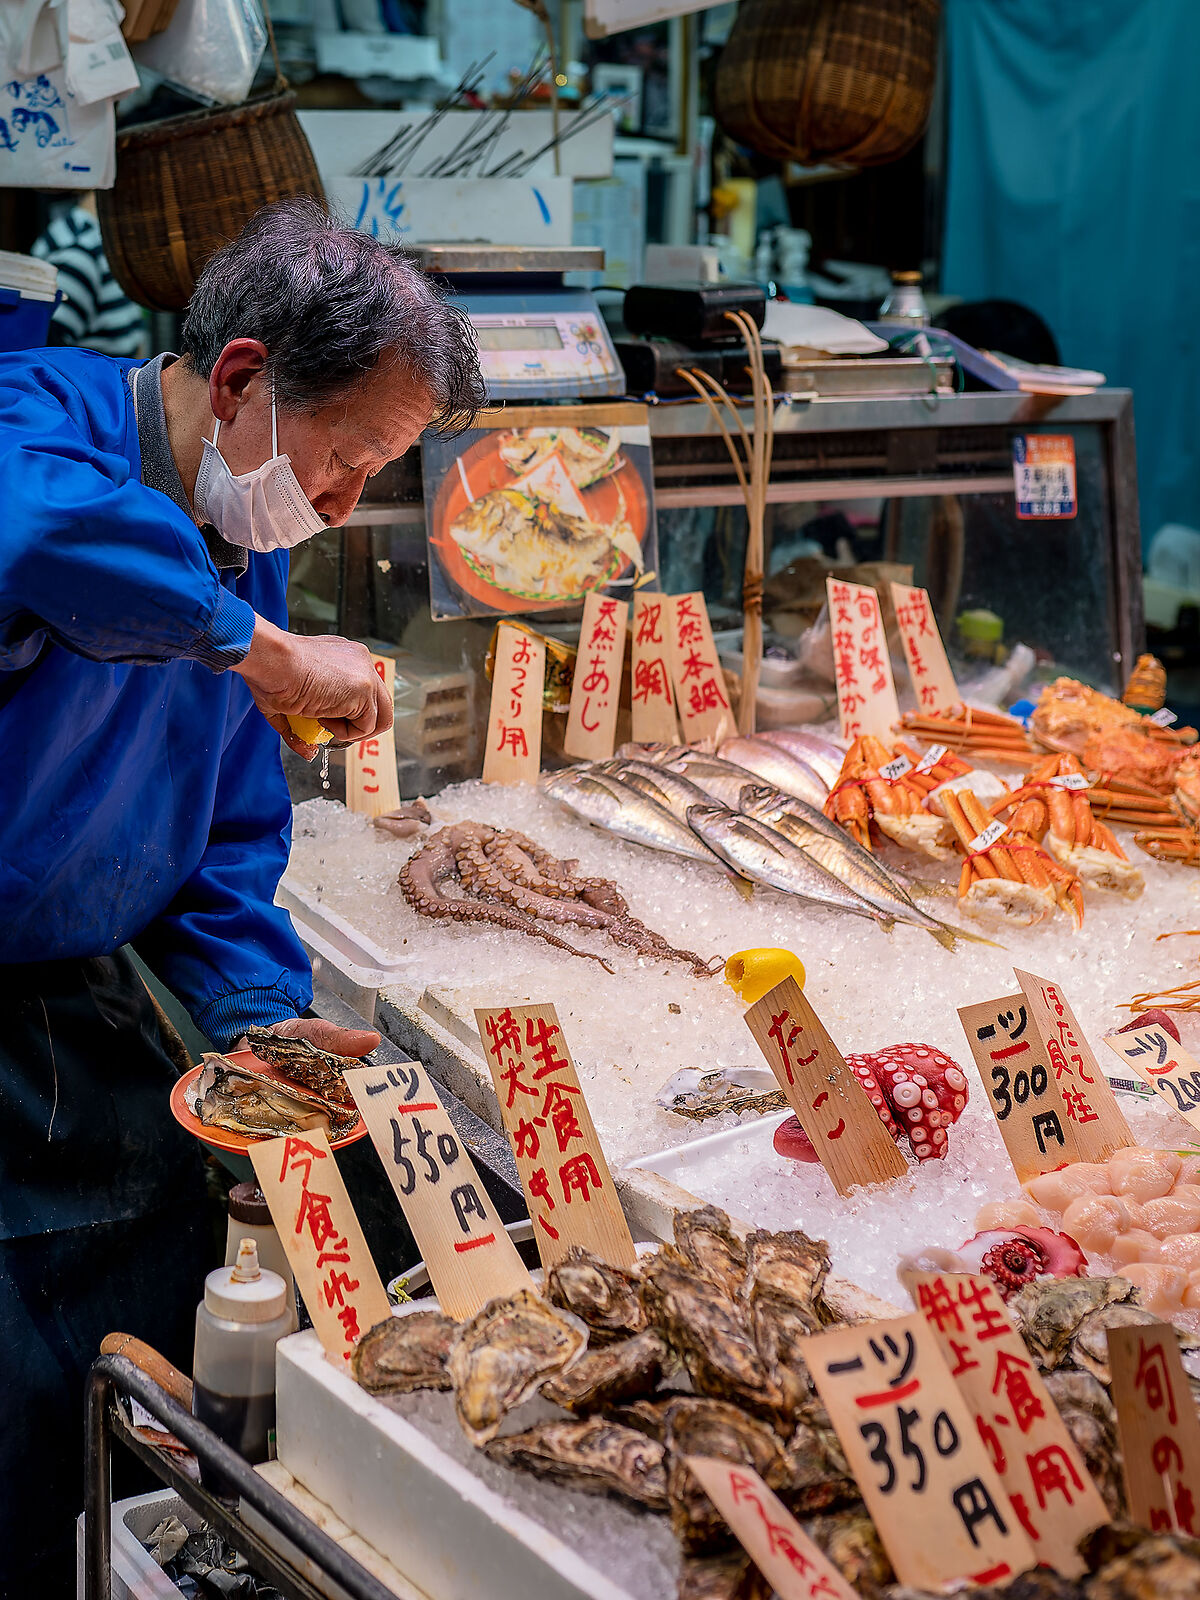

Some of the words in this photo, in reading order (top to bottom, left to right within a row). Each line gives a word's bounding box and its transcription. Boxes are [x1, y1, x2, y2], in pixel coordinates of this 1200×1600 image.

[497, 637, 538, 758] おつくり用
[581, 600, 619, 732] 天然あじ
[991, 1063, 1049, 1121] 300
[1041, 986, 1095, 1085] ほたて
[525, 1017, 603, 1204] 生食用
[279, 1137, 360, 1360] 今食べれま
[860, 1406, 960, 1495] 350
[958, 1279, 1086, 1511] 生食用
[952, 1477, 1009, 1547] 円
